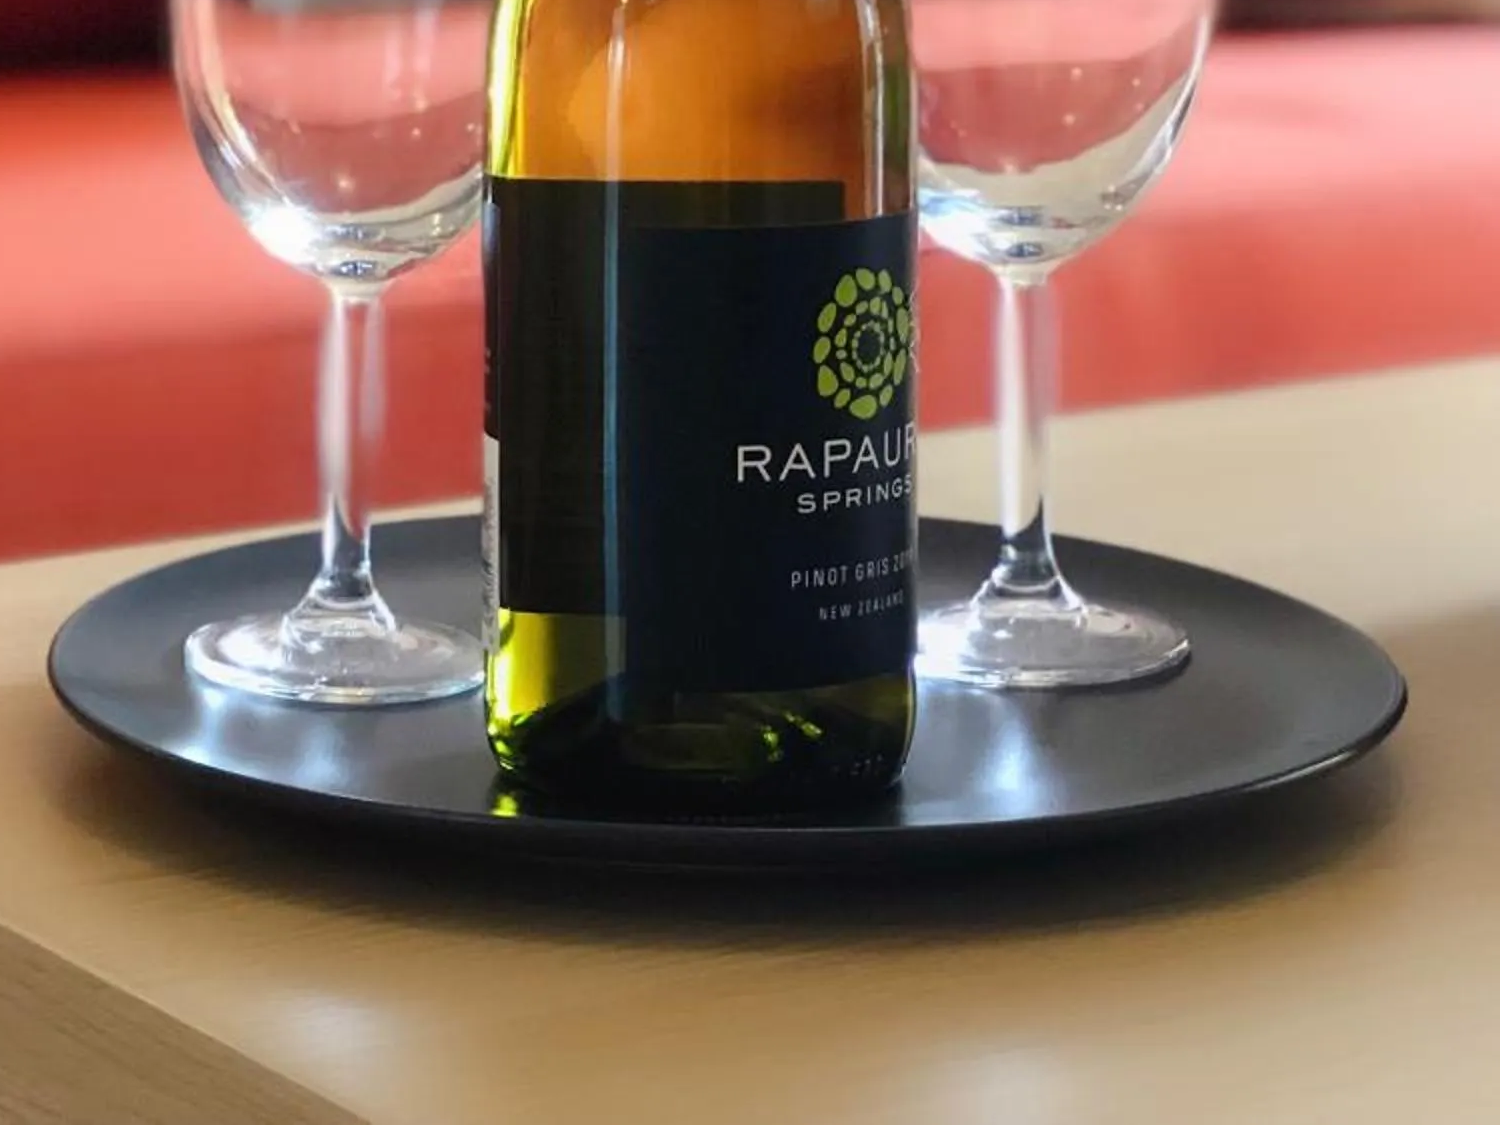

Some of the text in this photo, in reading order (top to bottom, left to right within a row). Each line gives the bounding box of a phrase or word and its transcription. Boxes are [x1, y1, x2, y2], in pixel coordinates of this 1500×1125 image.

[797, 474, 912, 513] SPRINGS
[791, 566, 848, 588] PINOT
[855, 557, 889, 582] GRIS
[819, 603, 852, 620] NEW
